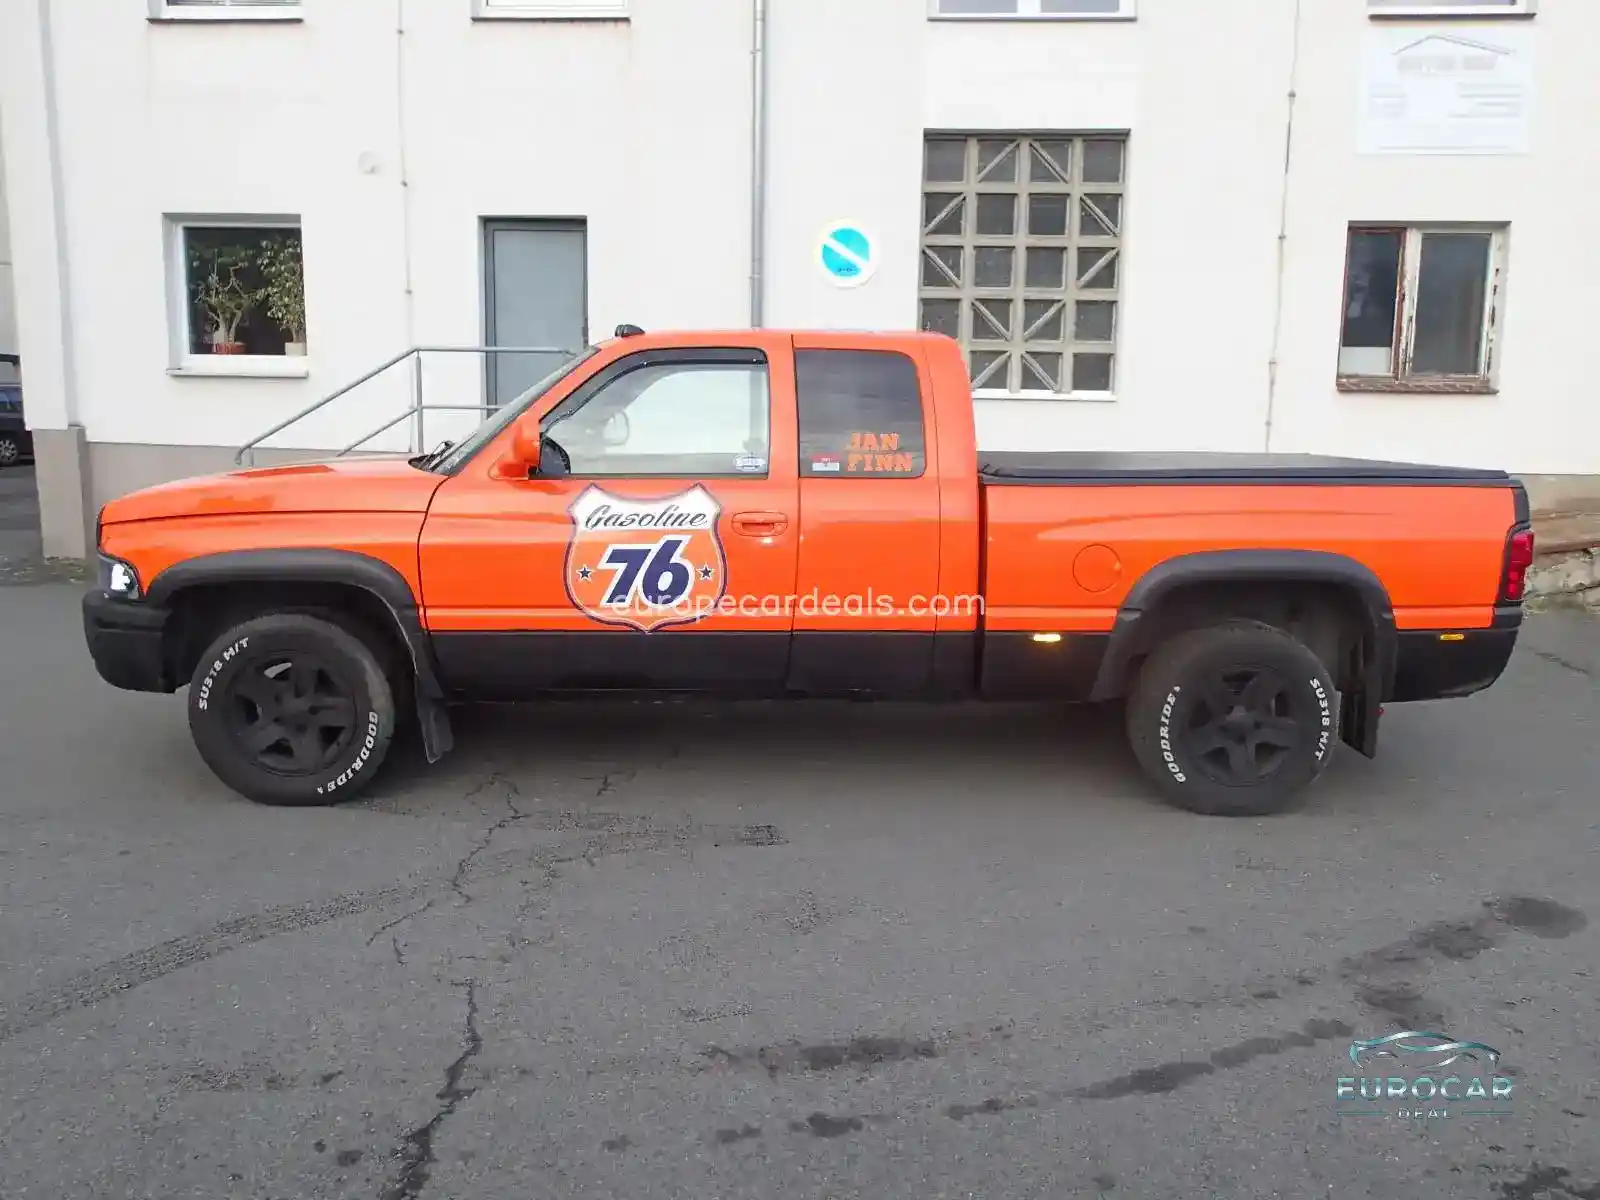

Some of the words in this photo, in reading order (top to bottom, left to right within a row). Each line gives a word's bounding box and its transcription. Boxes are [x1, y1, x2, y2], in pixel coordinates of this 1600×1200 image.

[845, 432, 900, 451] JAN
[847, 452, 913, 472] FINN
[585, 504, 708, 530] Gasoline
[600, 537, 694, 609] 76
[199, 659, 223, 711] SU318
[223, 636, 250, 662] H/T
[1309, 677, 1331, 726] SU318
[326, 711, 379, 793] GOODRIDE
[1159, 691, 1187, 783] GOODRIDE
[1314, 730, 1330, 761] H/T
